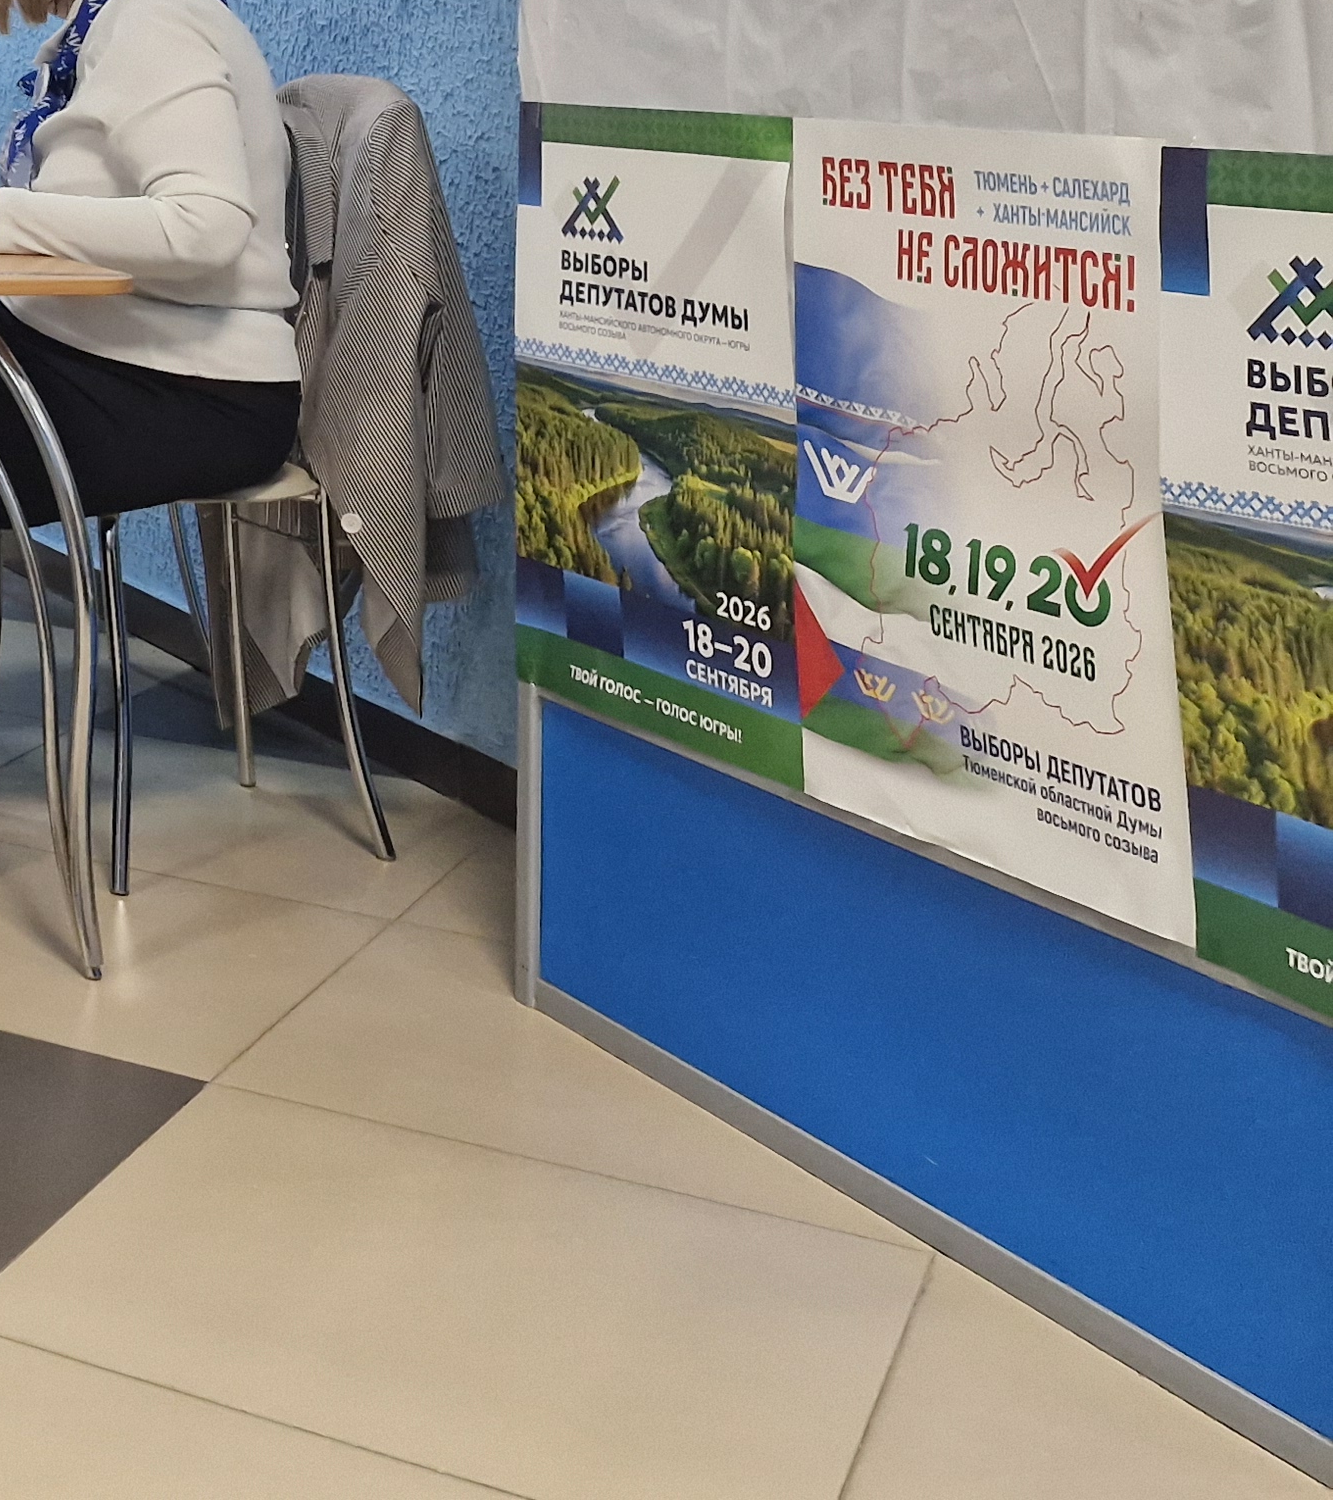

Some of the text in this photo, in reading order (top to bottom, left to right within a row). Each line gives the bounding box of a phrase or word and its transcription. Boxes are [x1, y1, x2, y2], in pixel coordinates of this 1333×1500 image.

[822, 157, 955, 218] БЕЗ ТЕБЯ
[974, 170, 1037, 195] ТЮМЕНЬ
[1052, 177, 1130, 207] САЛЕХАРД
[993, 202, 1132, 236] ХАНТЫ-МАНСИЙСК
[561, 250, 648, 282] ВЫБОРЫ
[897, 229, 1135, 312] НЕ СЛОЖИТСЯ!
[560, 279, 749, 331] ДЕПУТАТОВ ДУМЫ
[1247, 358, 1333, 397] ВЫБ
[1248, 460, 1328, 482] ВОСЬМОГО
[715, 591, 771, 631] 2026
[929, 604, 1096, 682] СЕНТЯБРЯ 2026
[570, 664, 598, 687] ТВОЙ
[599, 677, 641, 704] ГОЛОС
[656, 698, 698, 726] ГОЛОС
[699, 714, 743, 743] ЮГРЫ!
[686, 659, 773, 708] СЕНТЯБРЯ
[960, 724, 1162, 812] ВЫБОРЫ ДЕПУТАТОВ
[962, 754, 1163, 839] Тюменской областной Думы
[1036, 807, 1159, 864] восьмого созыва
